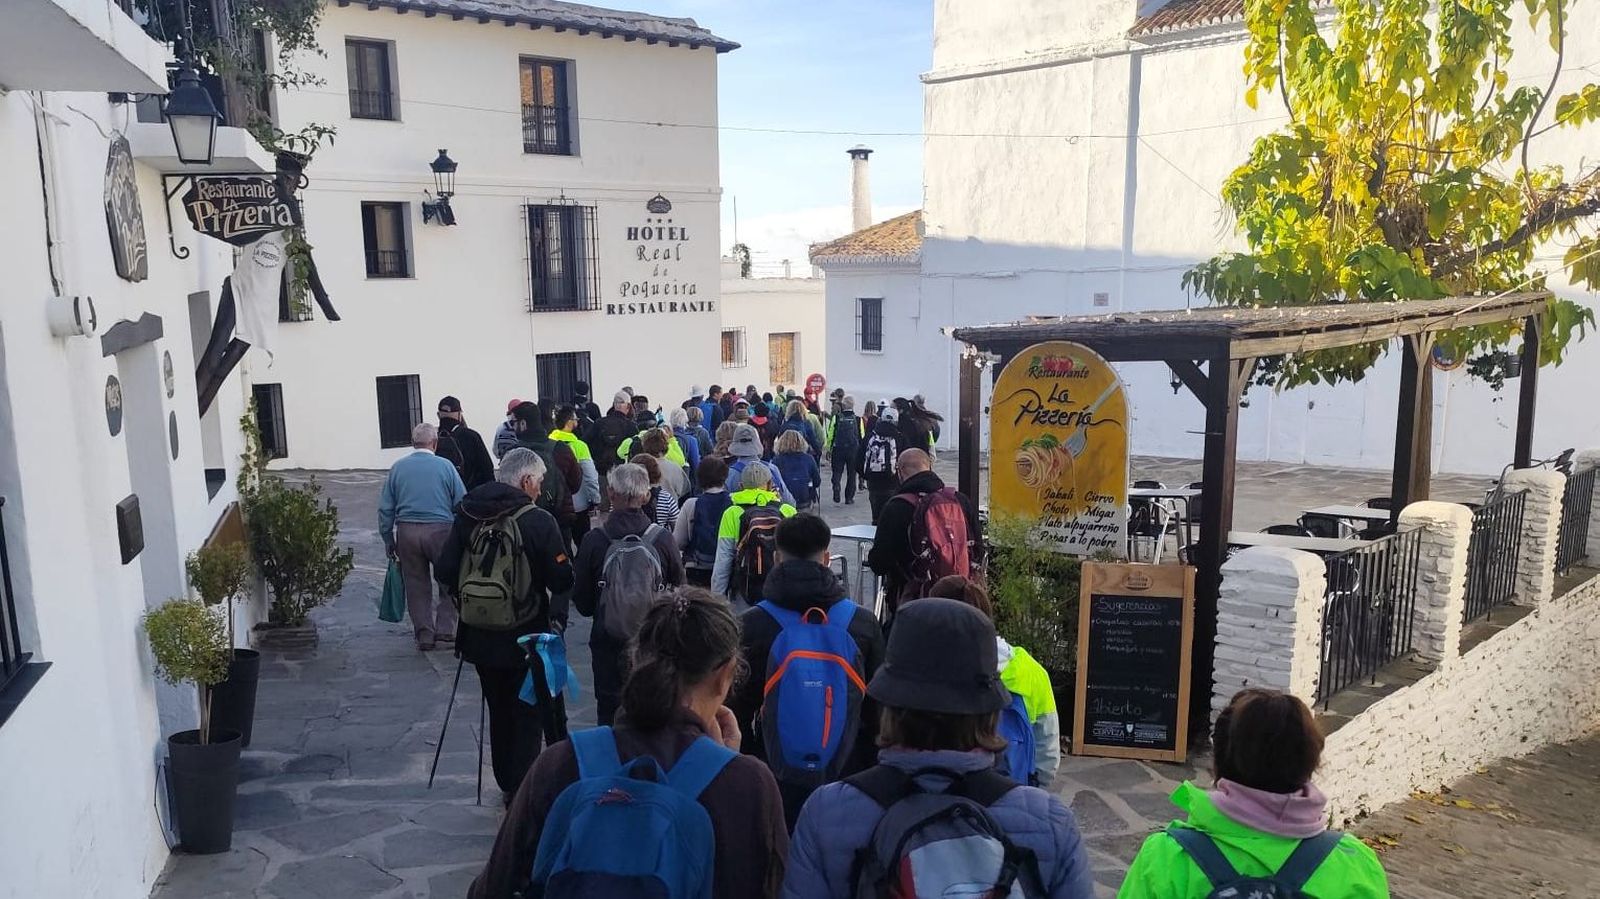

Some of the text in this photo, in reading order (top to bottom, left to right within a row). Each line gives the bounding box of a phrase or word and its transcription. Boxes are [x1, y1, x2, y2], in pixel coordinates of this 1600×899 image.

[198, 181, 276, 200] Restaurante
[222, 199, 240, 211] LA
[187, 198, 295, 239] Pizzería
[626, 226, 689, 241] HOTEL
[636, 243, 682, 262] Real
[653, 264, 668, 277] de
[620, 279, 697, 298] Poqueira
[606, 301, 716, 316] RESTAURANTE
[1028, 366, 1090, 380] Restaurante
[1047, 383, 1076, 403] La
[1011, 389, 1100, 428] Pizzería
[1084, 490, 1115, 504] Ciervo
[1042, 501, 1116, 523] Choto Migas
[1064, 516, 1120, 537] alpujarreño
[1069, 537, 1077, 545] a
[1079, 531, 1087, 545] lo
[1086, 534, 1117, 551] pobre
